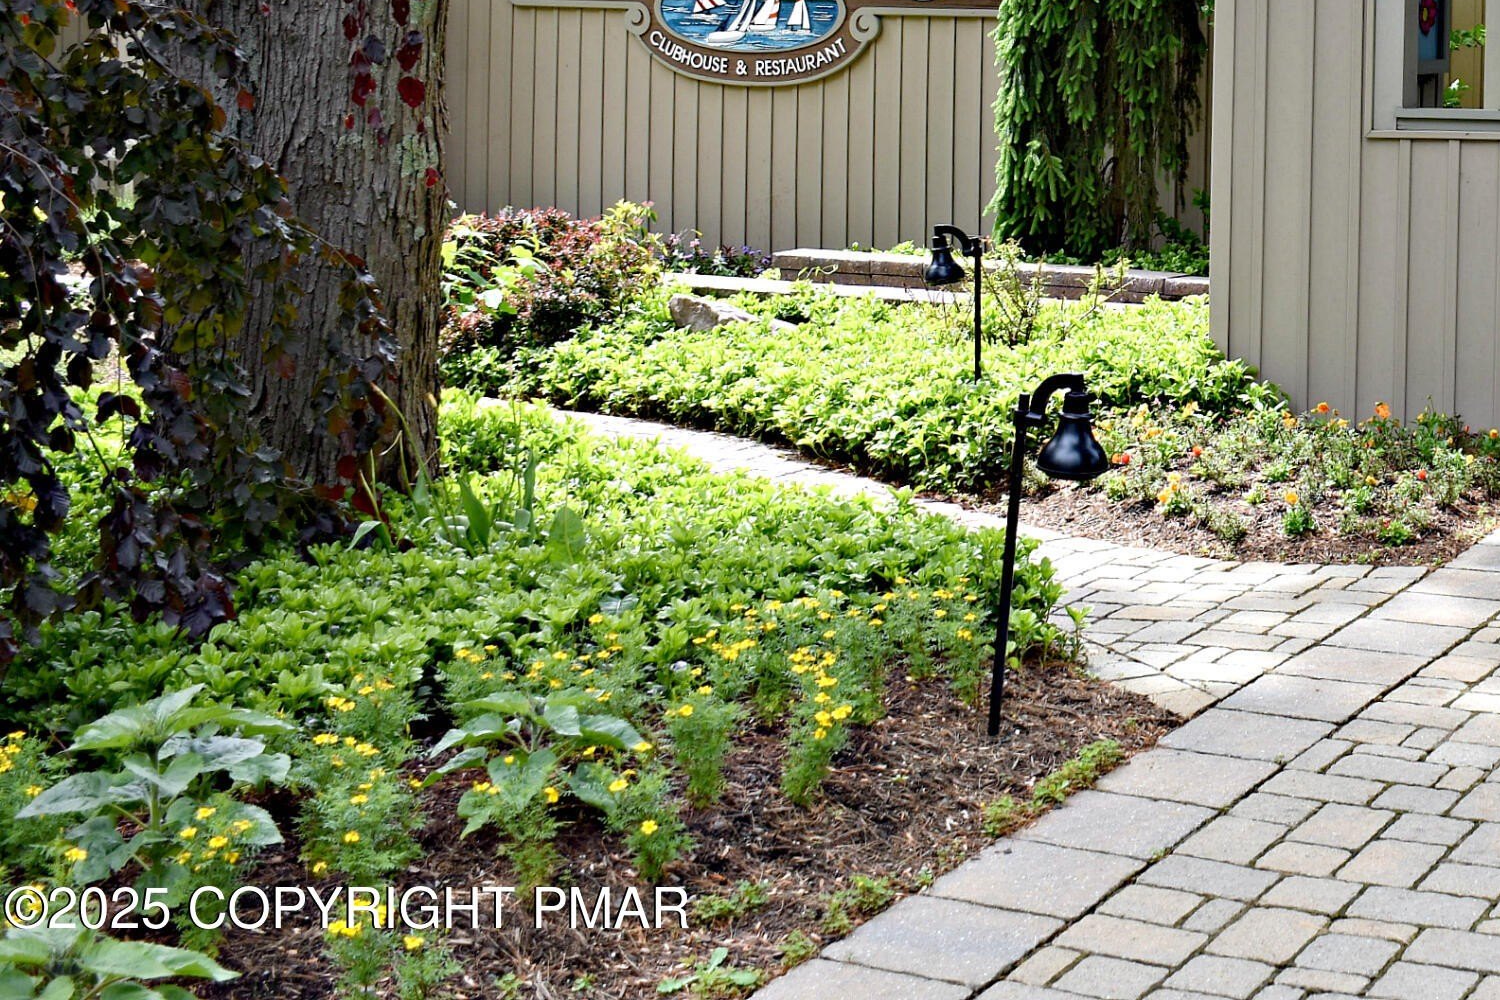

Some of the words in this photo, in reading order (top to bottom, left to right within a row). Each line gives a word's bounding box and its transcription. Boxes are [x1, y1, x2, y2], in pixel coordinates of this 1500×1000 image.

[649, 30, 729, 74] CLUBHOUSE
[736, 60, 747, 76] &
[755, 37, 847, 76] RESTAURANT
